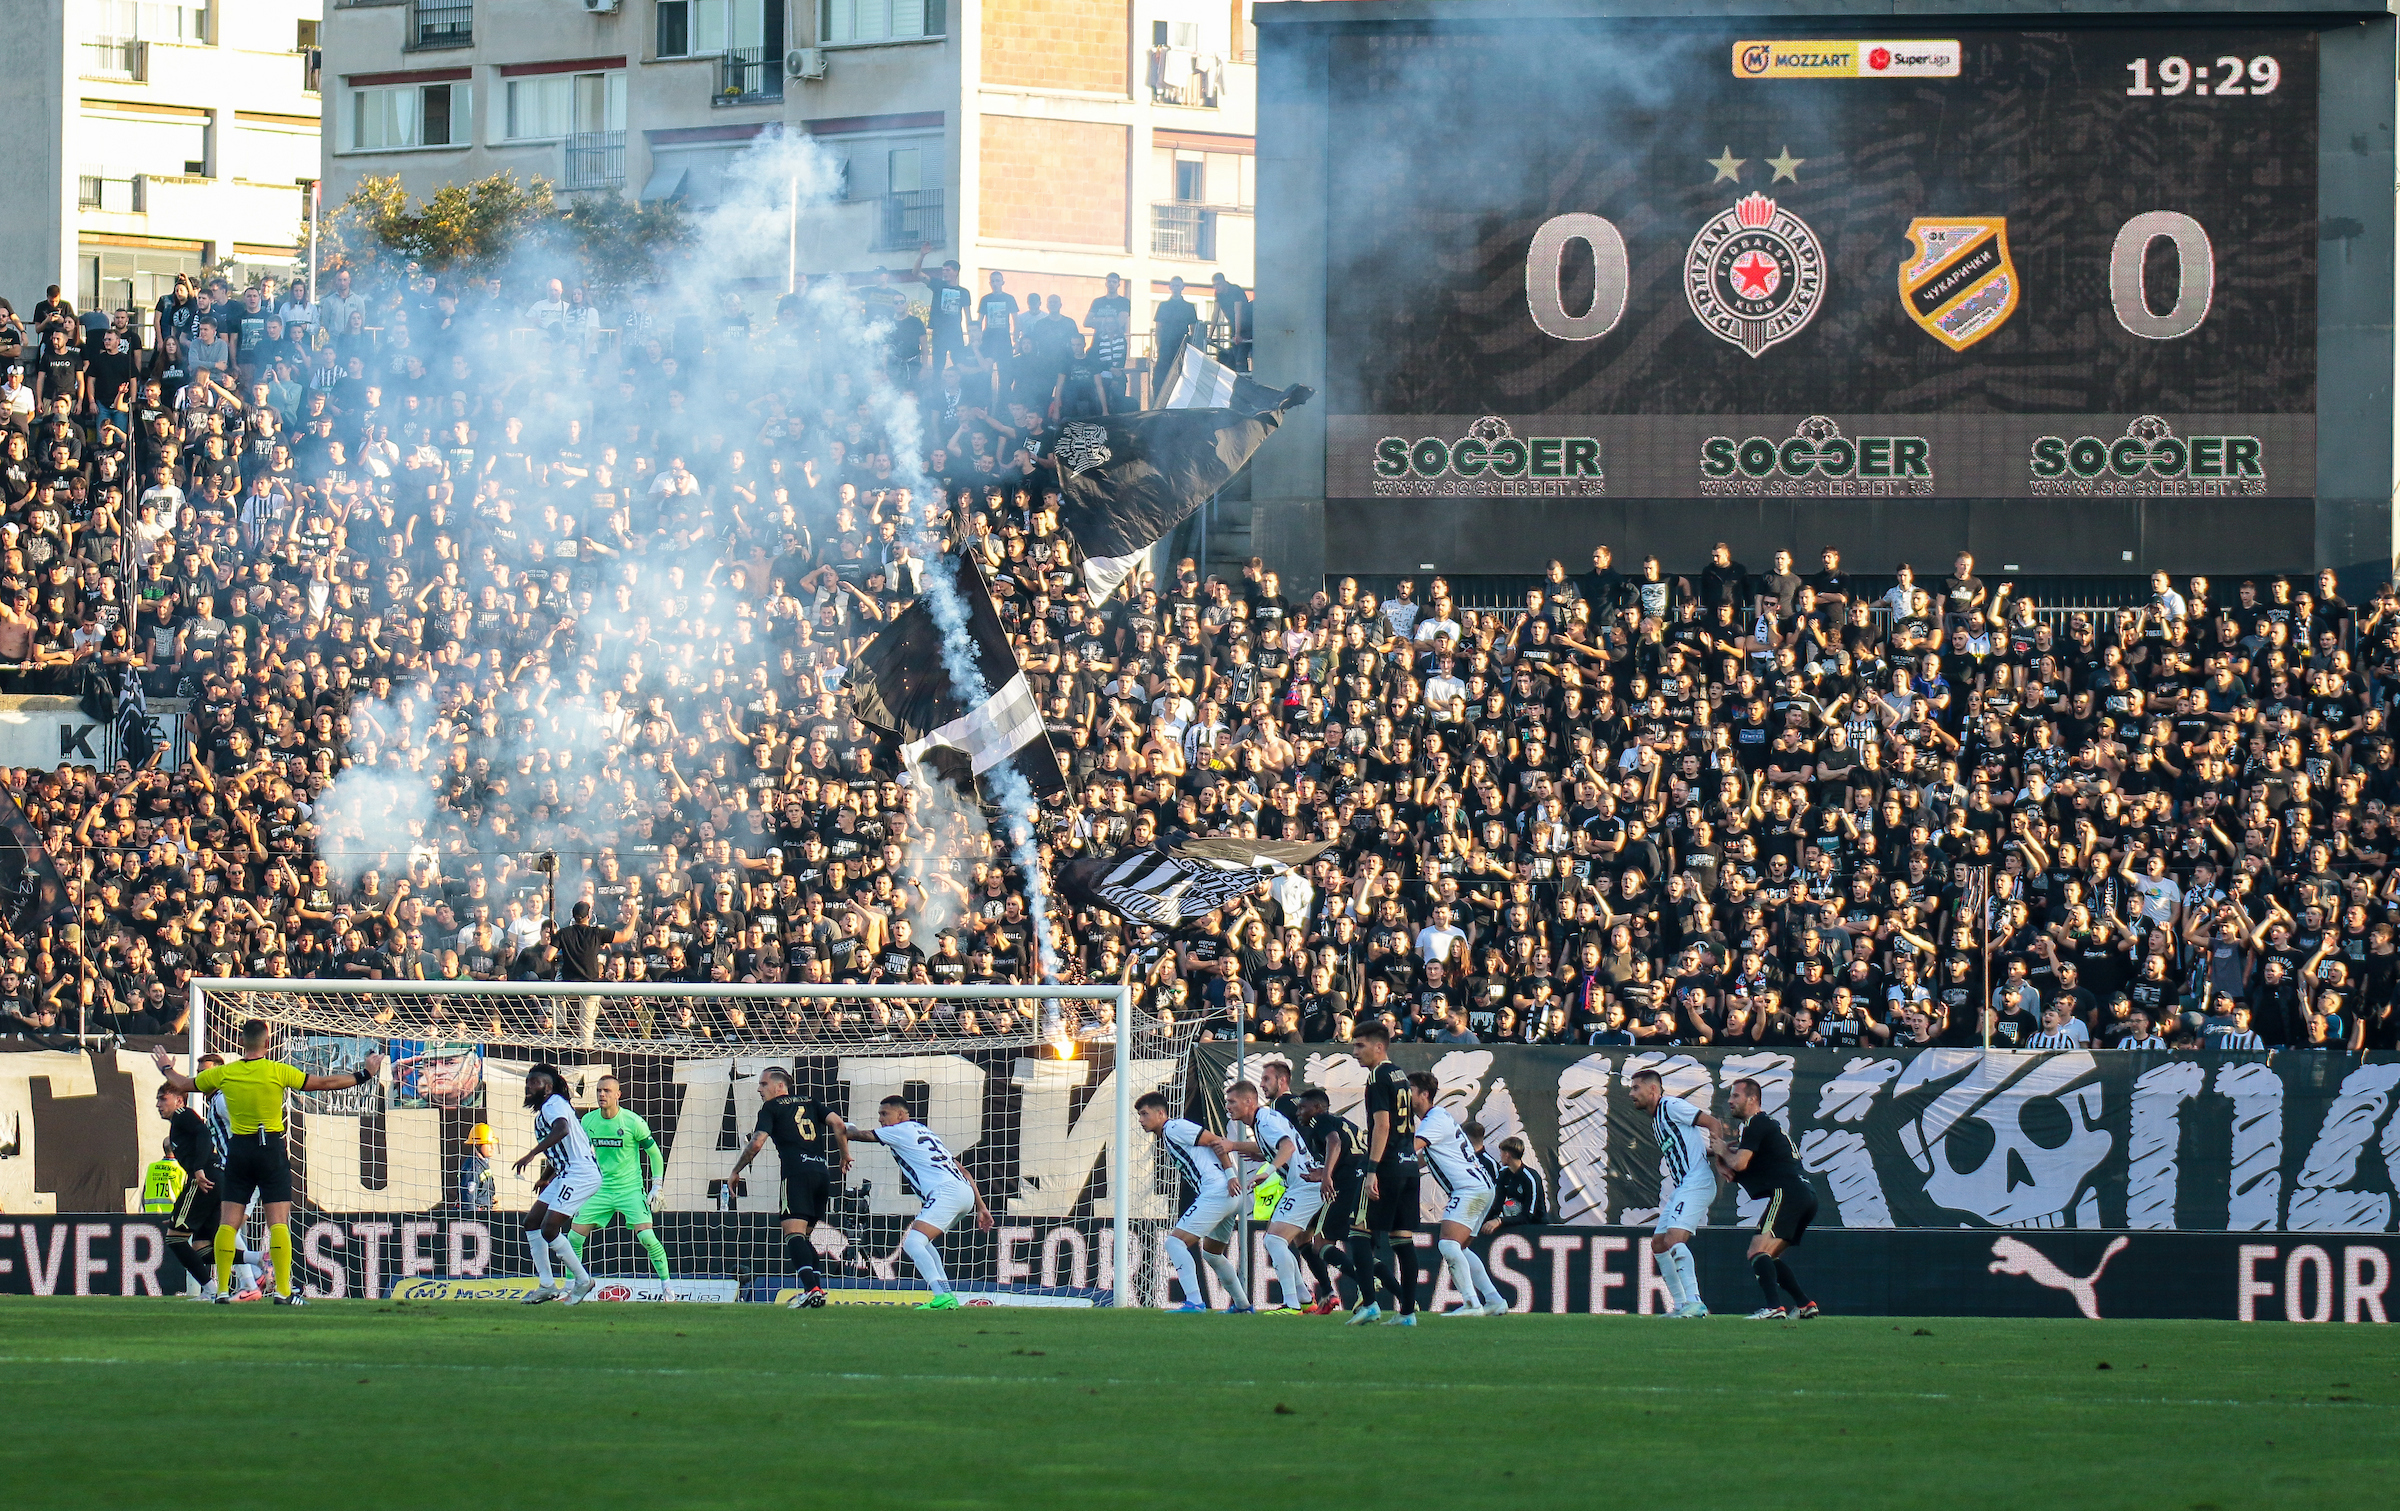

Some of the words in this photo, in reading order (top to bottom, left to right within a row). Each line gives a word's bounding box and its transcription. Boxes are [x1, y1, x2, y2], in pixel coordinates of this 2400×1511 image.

[1775, 54, 1849, 67] MOZZART
[1894, 53, 1951, 67] SuperLiga
[2126, 56, 2280, 96] 19:29
[1718, 237, 1790, 277] FUDBALSKI
[2109, 210, 2214, 339] 0
[1525, 212, 1628, 340] 0
[1688, 218, 1742, 338] PARTIZAN
[1922, 250, 1993, 302] ЧУКАРИЧКИ
[1735, 299, 1776, 312] KLUB
[1373, 436, 1603, 478] SOCCER
[1701, 436, 1932, 478] SOCCER
[2030, 436, 2265, 478] SOCCER
[494, 527, 517, 539] PUMA
[61, 724, 97, 759] K
[1851, 731, 1866, 739] mts
[1842, 1036, 1856, 1046] 1926
[795, 1105, 817, 1141] 6
[156, 1183, 169, 1197] 179
[558, 1184, 574, 1201] 16
[1281, 1197, 1296, 1212] 26
[1674, 1201, 1685, 1215] 4
[304, 1221, 491, 1298] STER
[453, 1288, 540, 1300] MOZZA
[2238, 1244, 2390, 1323] FOR
